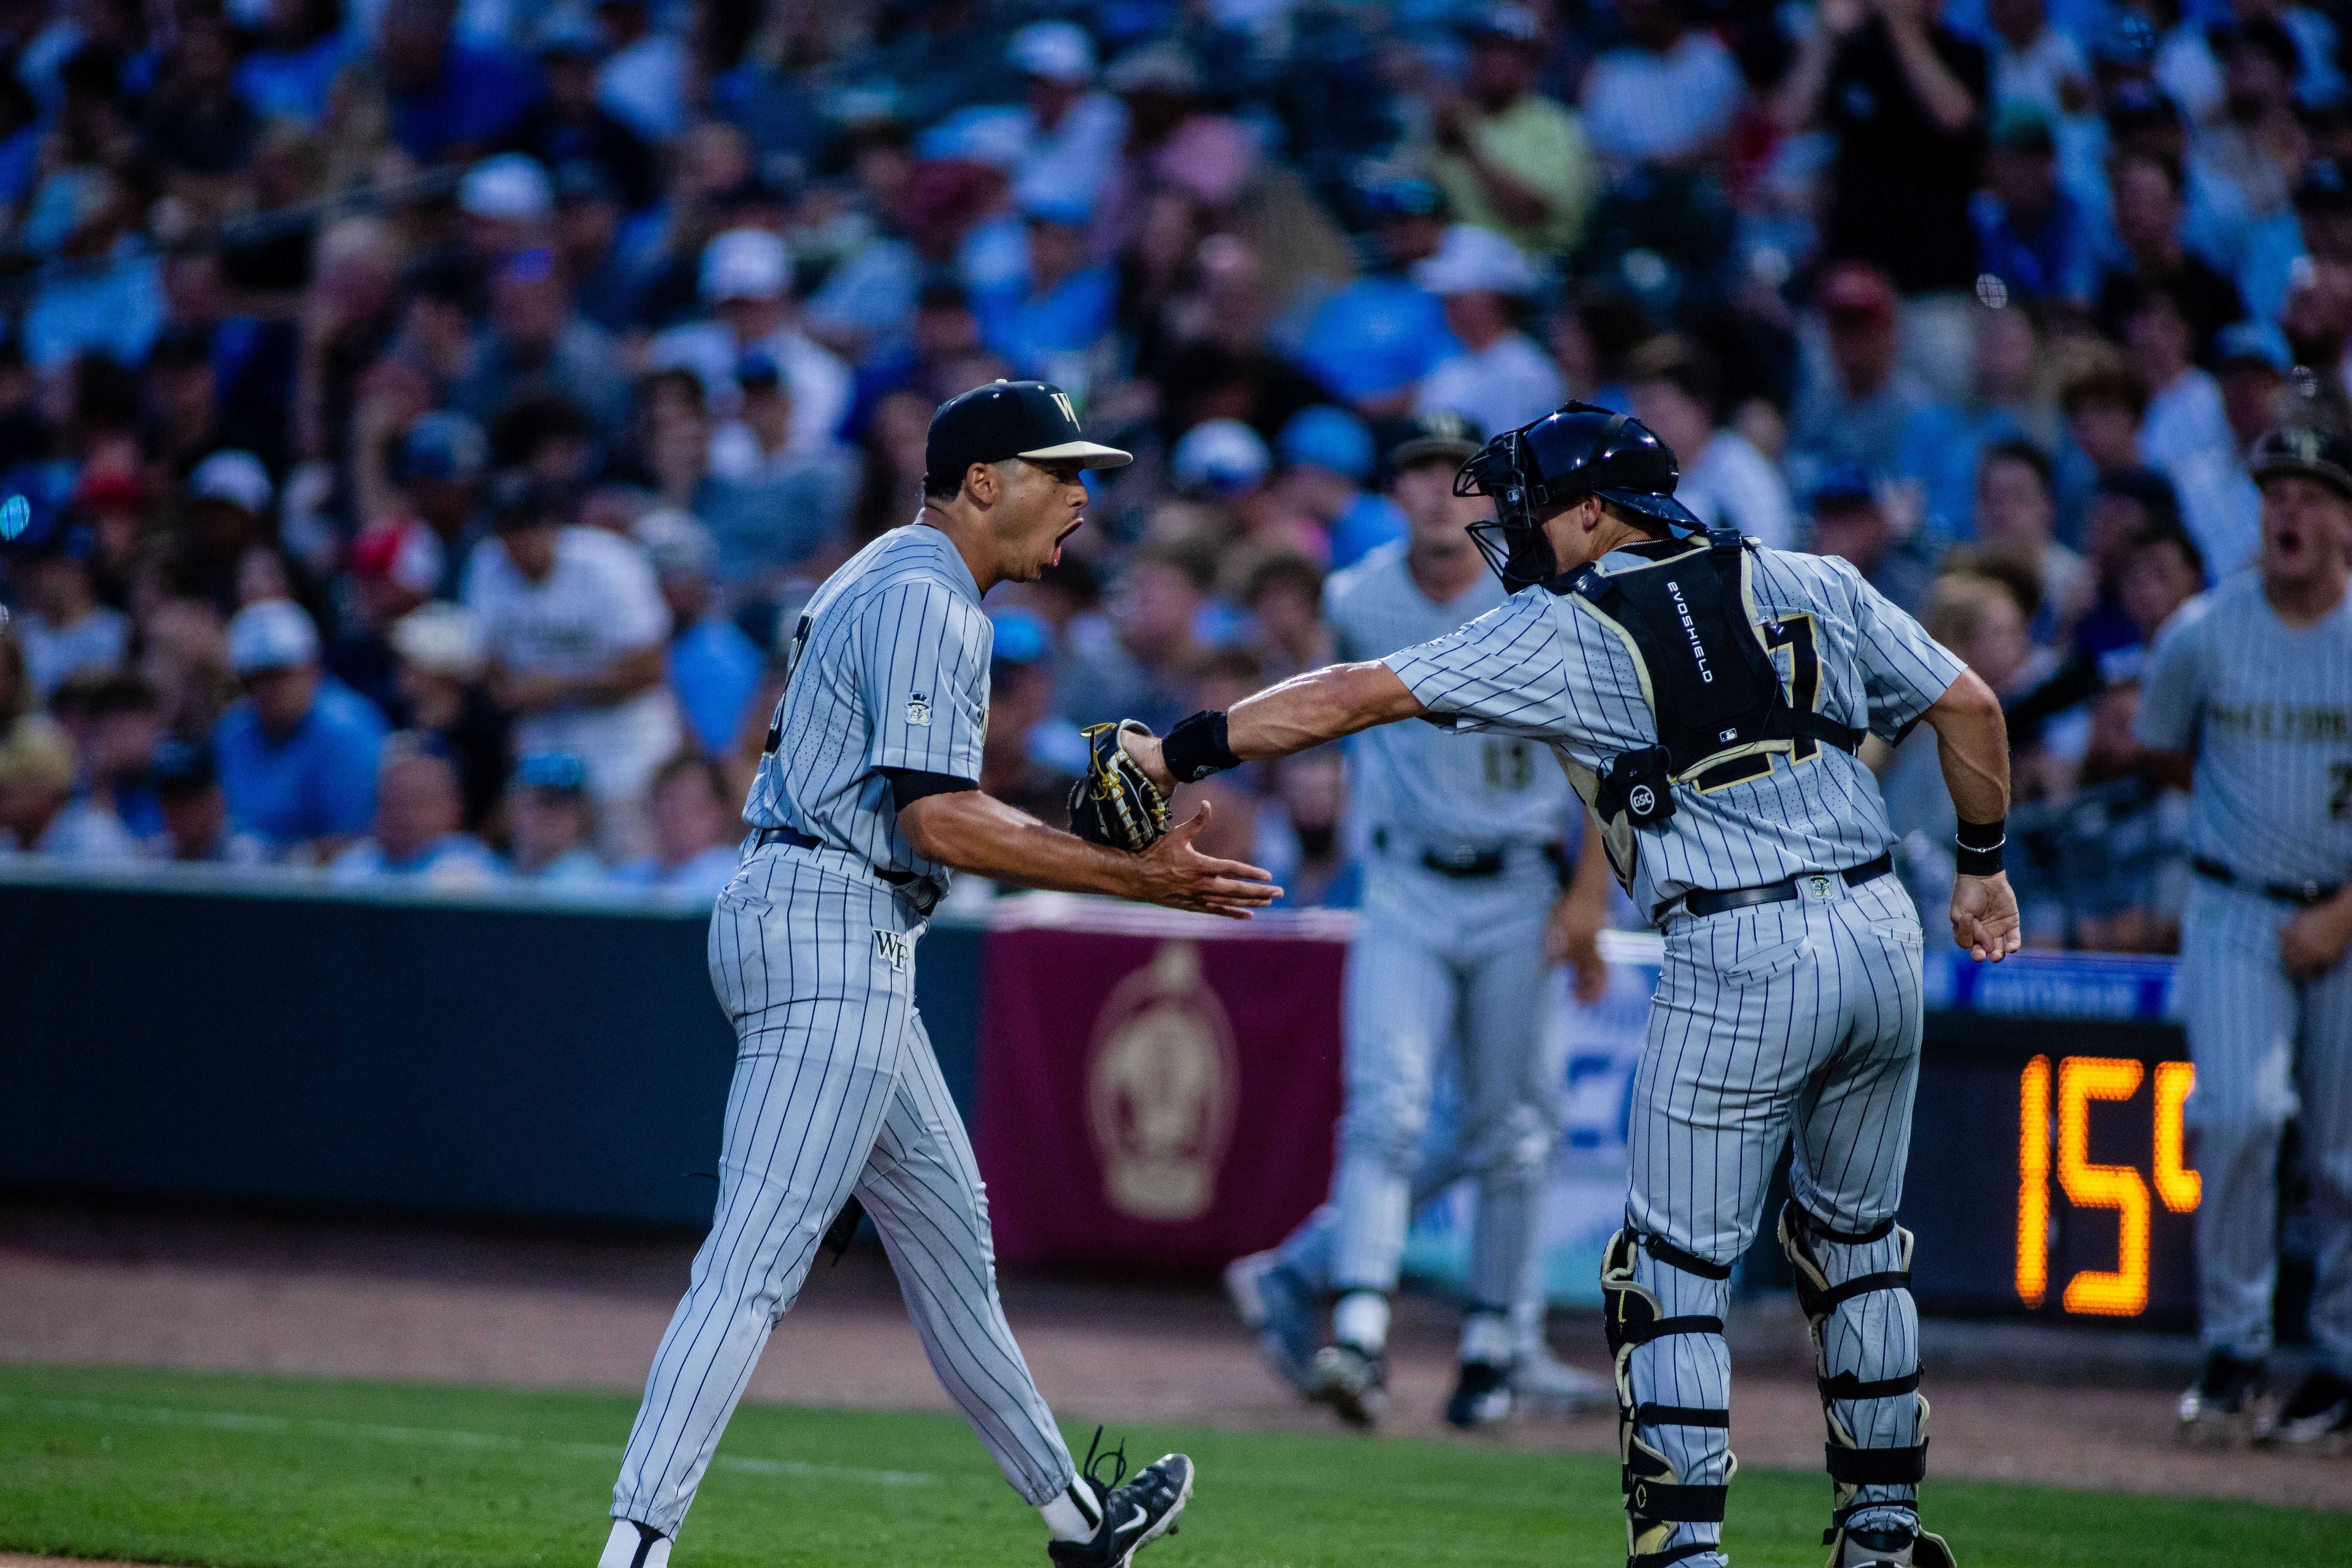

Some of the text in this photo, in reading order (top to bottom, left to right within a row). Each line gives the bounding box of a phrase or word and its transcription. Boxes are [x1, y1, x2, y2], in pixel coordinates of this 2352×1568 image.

[1050, 393, 1081, 432] W
[1667, 581, 1713, 682] EVOSHIELD
[1633, 792, 1652, 808] GSC
[873, 929, 908, 969] WF
